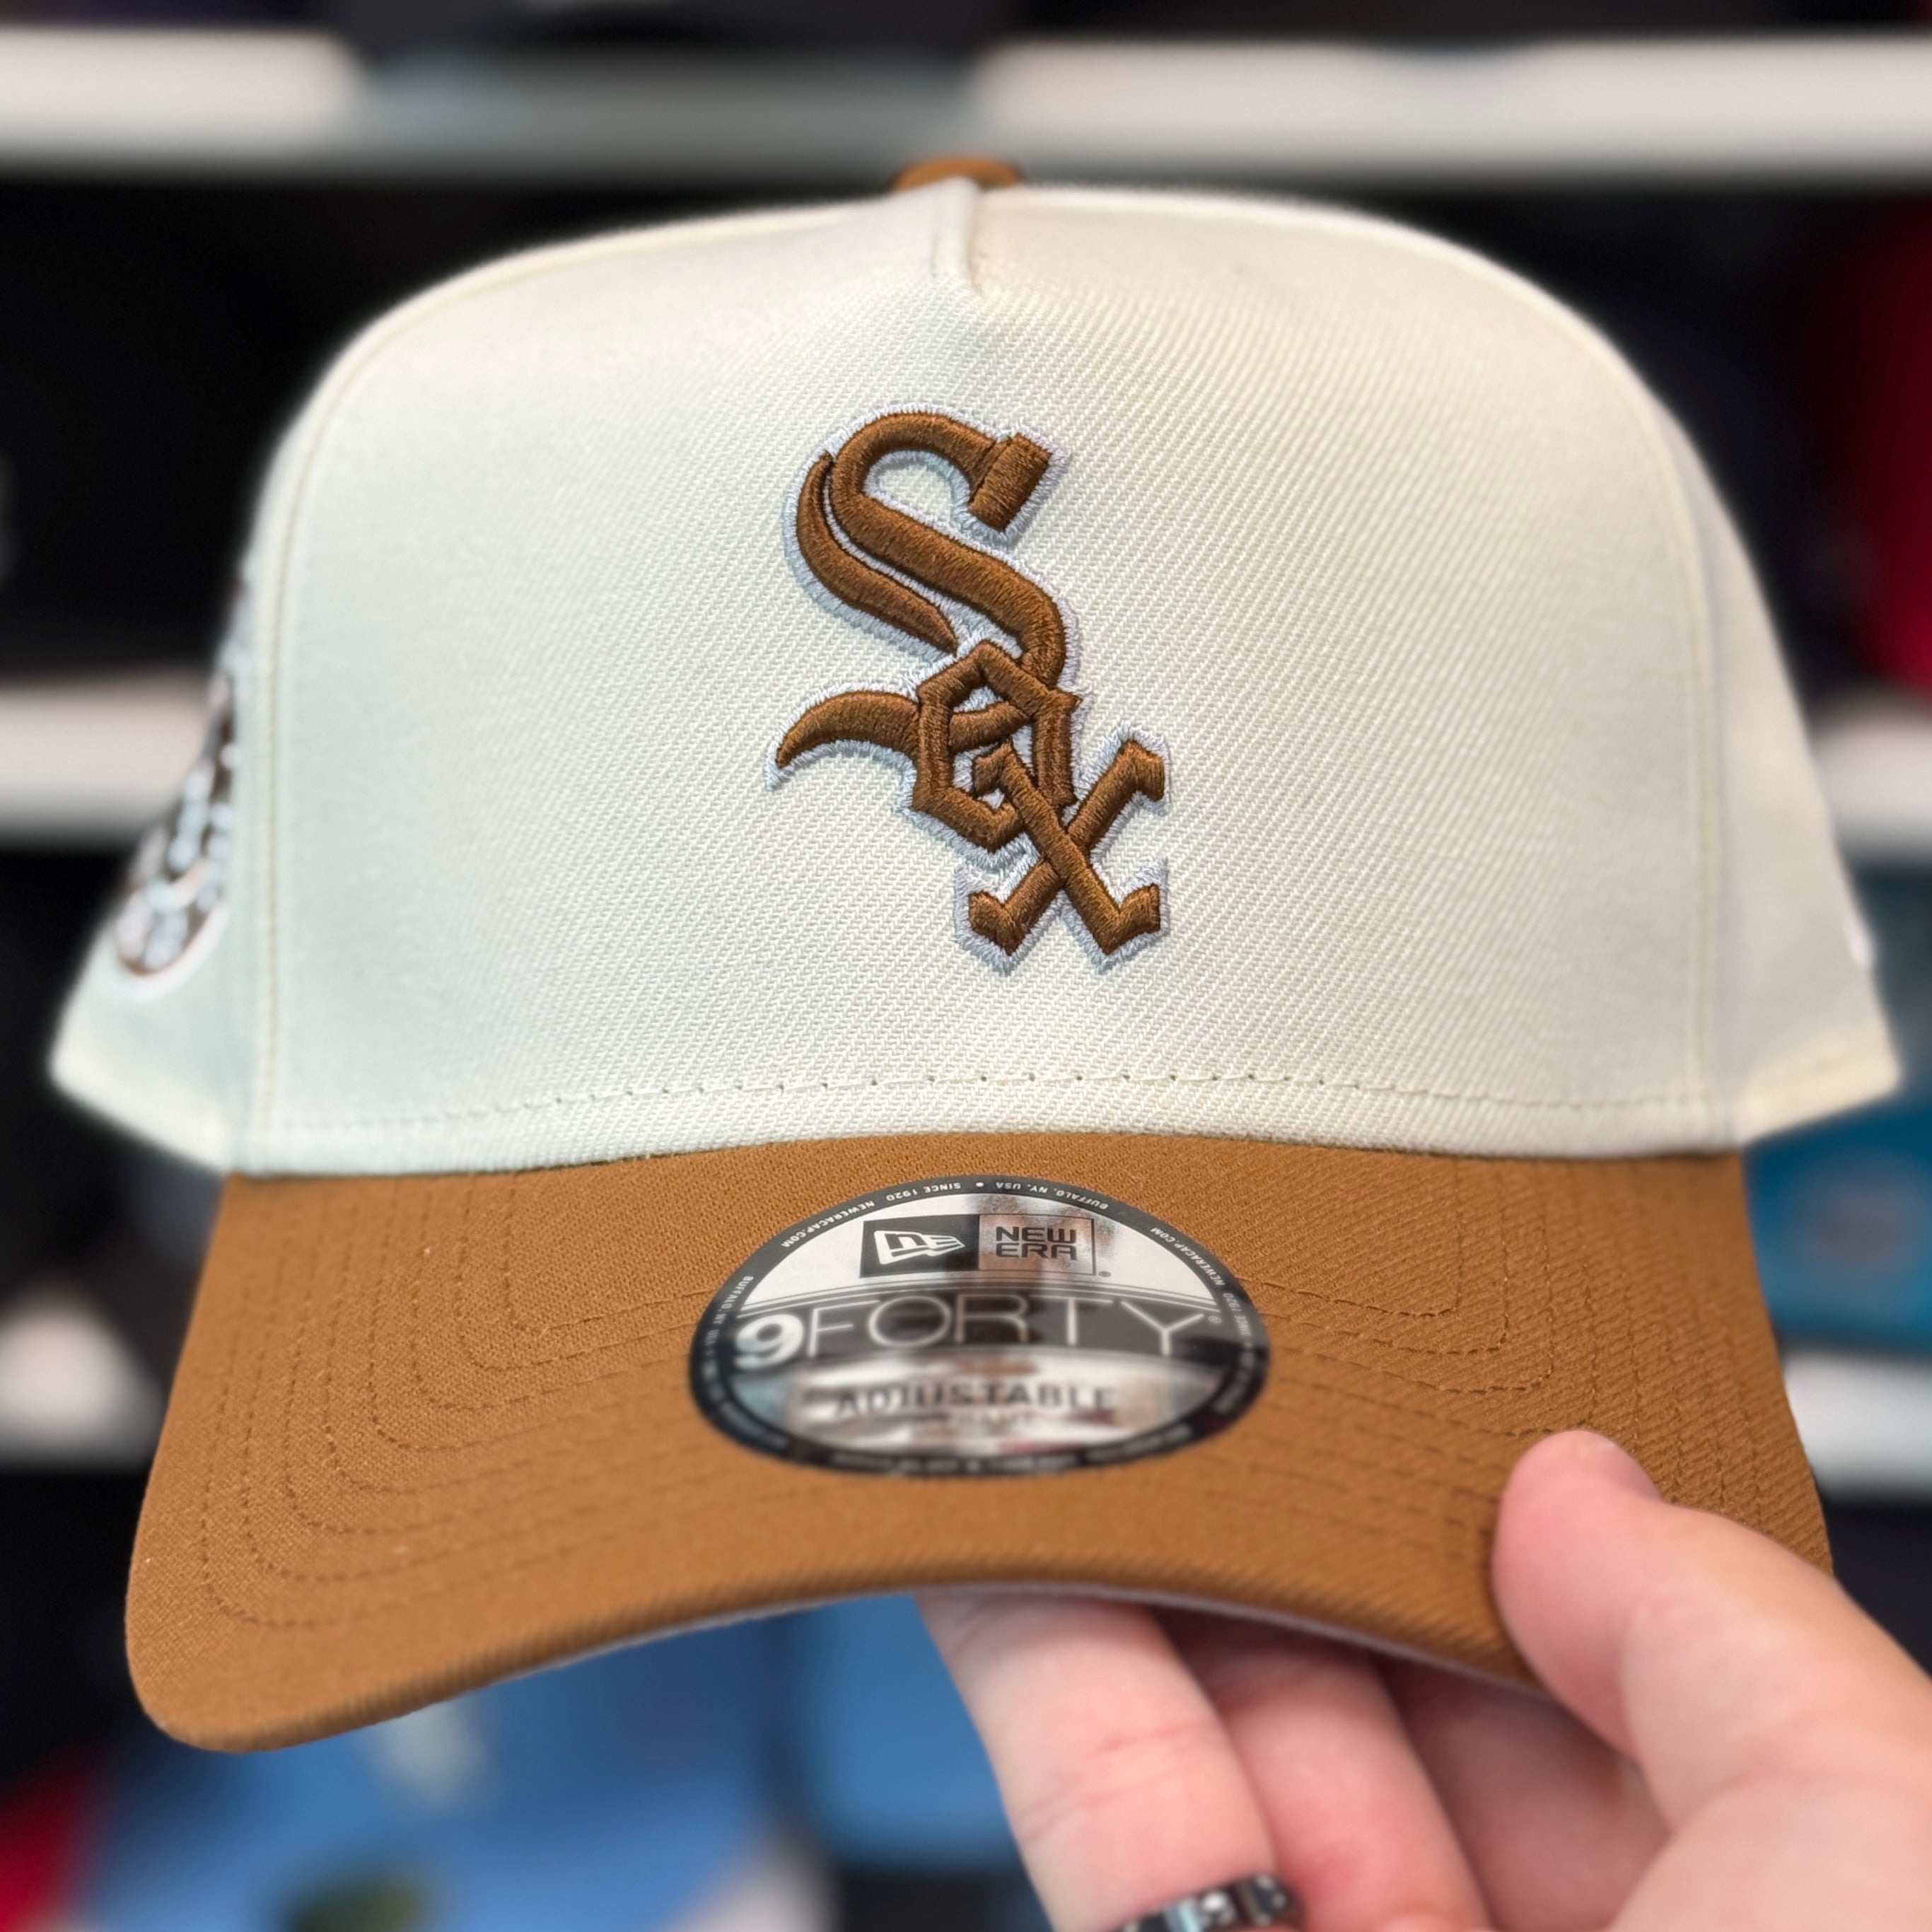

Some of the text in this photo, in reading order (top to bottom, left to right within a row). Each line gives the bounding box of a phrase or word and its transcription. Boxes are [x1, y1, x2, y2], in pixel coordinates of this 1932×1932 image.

[885, 1188, 918, 1201] 1920
[923, 1182, 962, 1194] SINCE
[995, 1182, 1021, 1190] USA
[781, 1200, 875, 1247] NEWERACAP.COM
[996, 1226, 1077, 1244] NEW
[996, 1243, 1078, 1261] ERA
[1150, 1227, 1226, 1286] NEWERACAP.COM
[734, 1293, 1204, 1370] 9FORTY
[836, 1380, 1117, 1414] ADJUSTABLE
